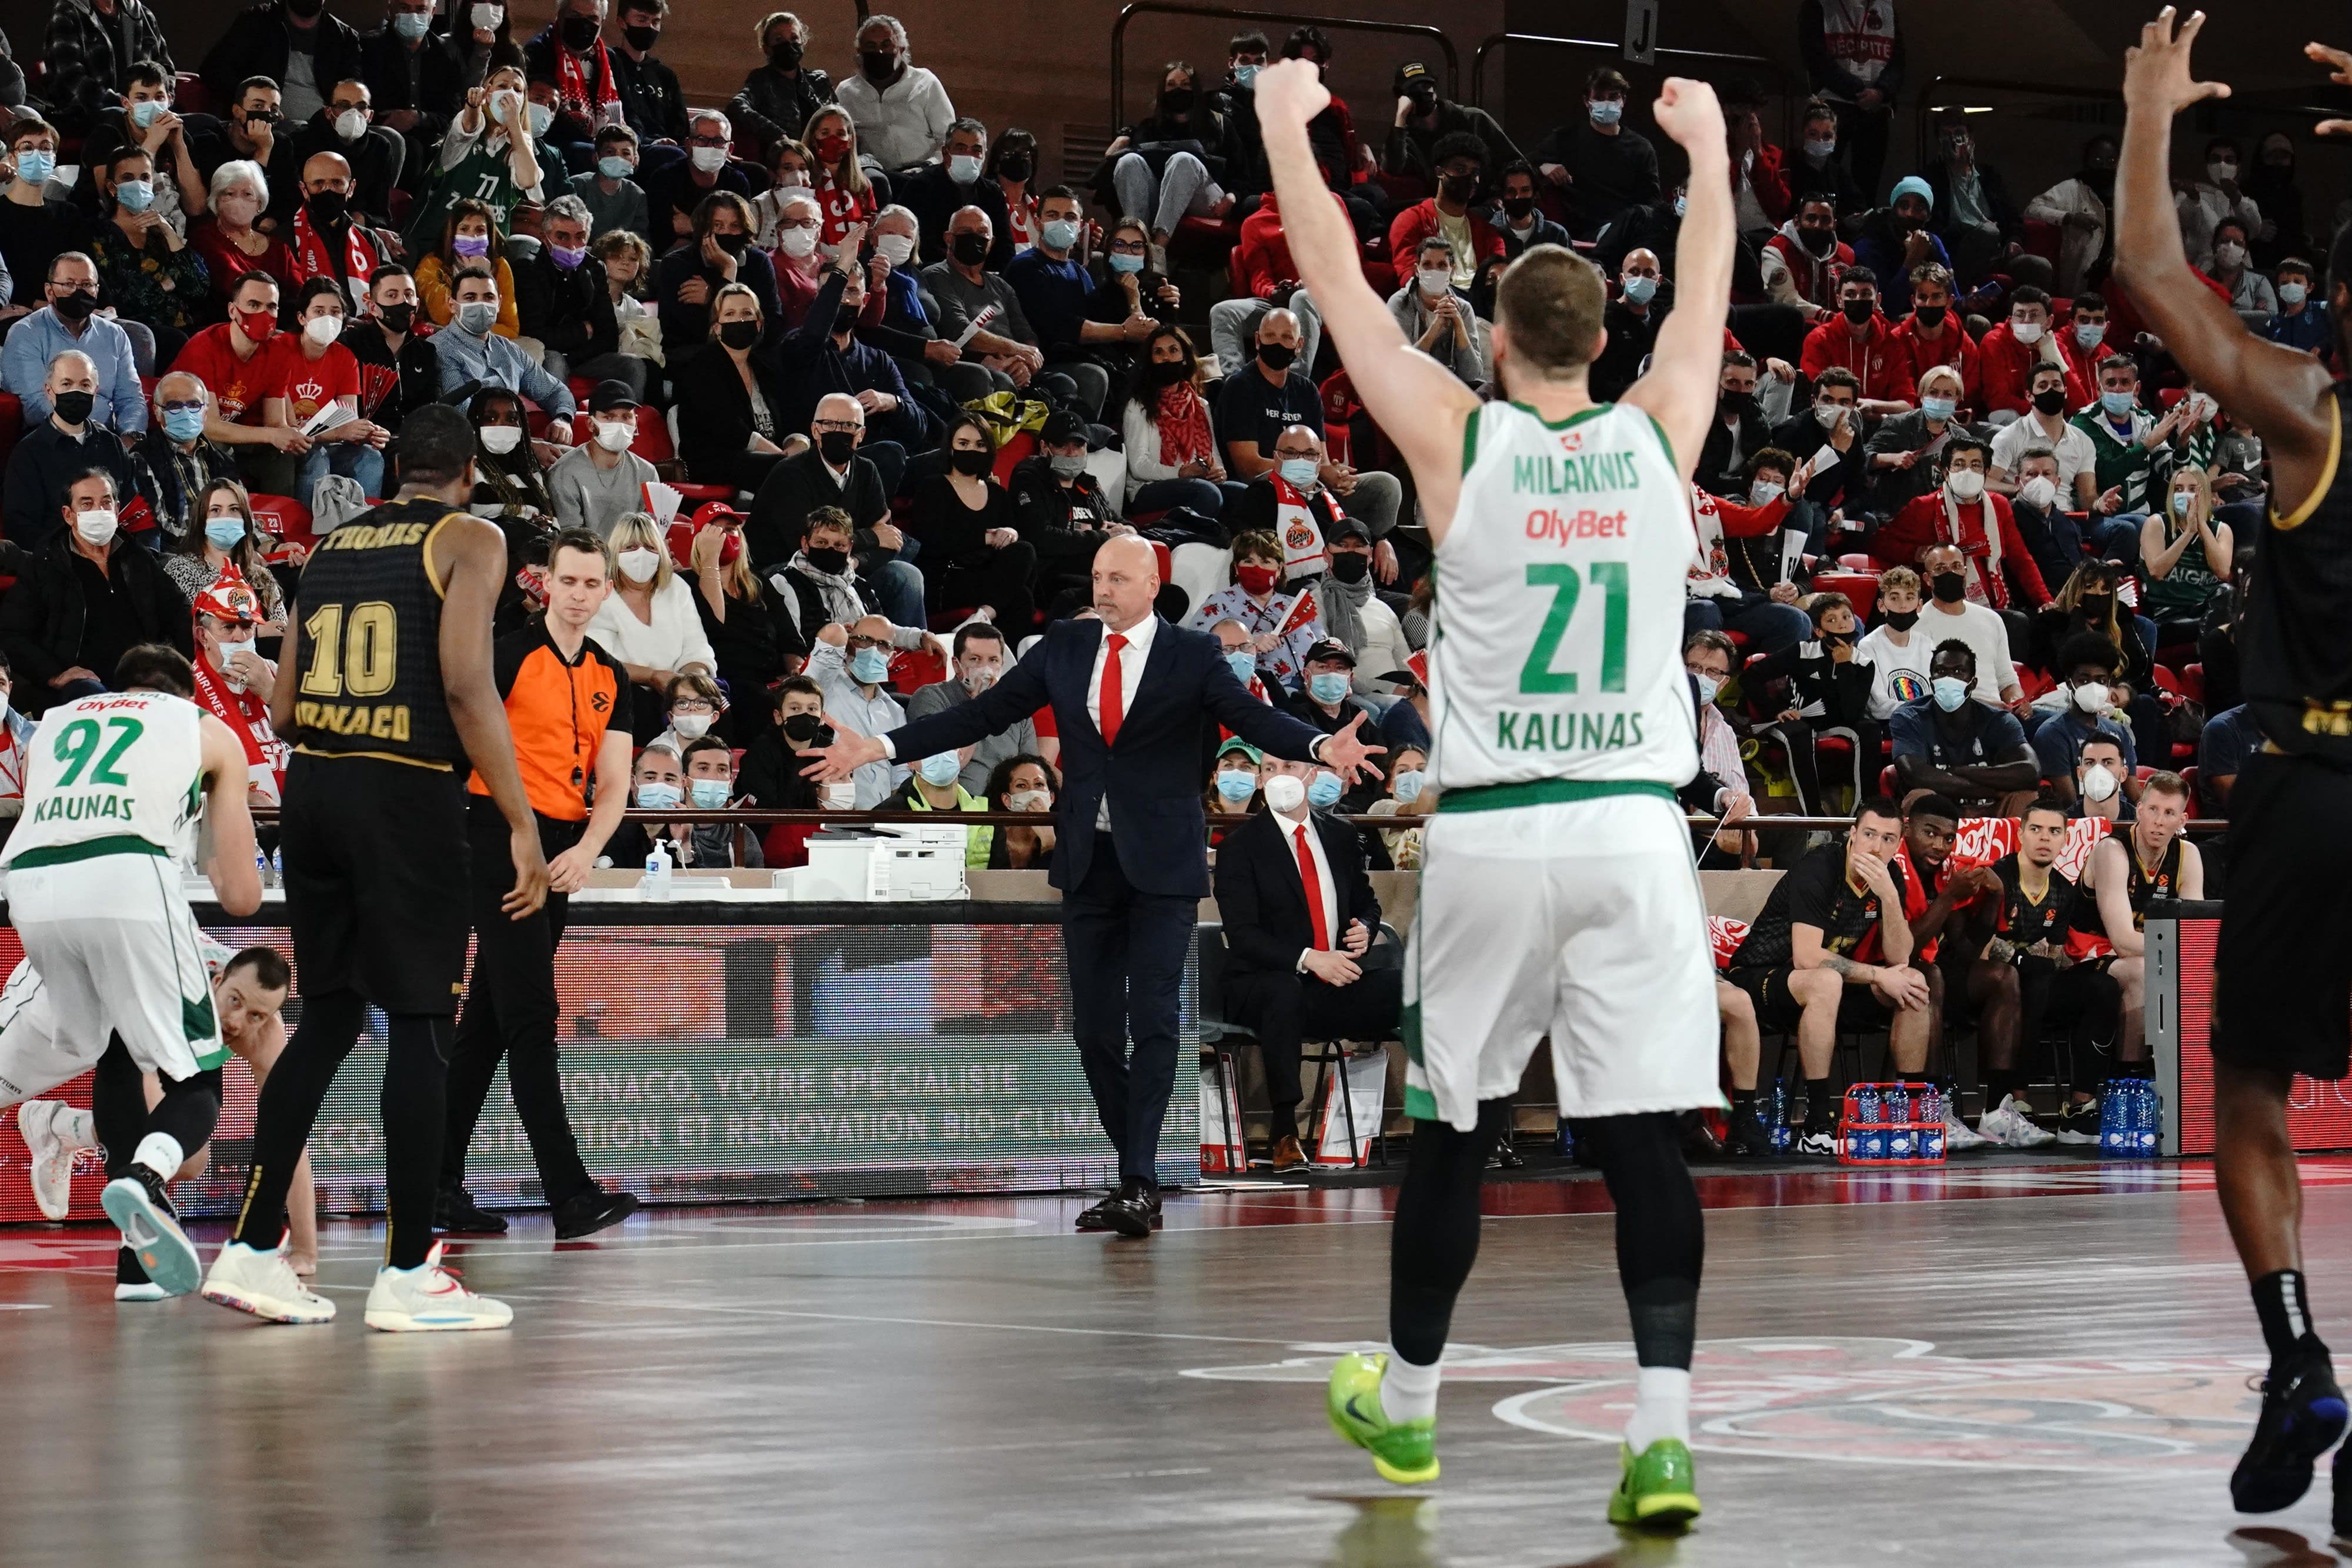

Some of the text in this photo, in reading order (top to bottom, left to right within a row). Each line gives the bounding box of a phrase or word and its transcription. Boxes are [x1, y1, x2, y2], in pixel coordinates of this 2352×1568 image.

[1632, 9, 1651, 54] J
[475, 173, 499, 200] 77
[1513, 450, 1641, 496] MILAKNIS
[268, 518, 278, 528] 23
[322, 523, 430, 551] THOMAS
[1525, 508, 1628, 548] OlyBet
[1519, 561, 1629, 694] 21
[300, 601, 397, 697] 10
[76, 698, 150, 712] OlyBet
[194, 671, 228, 718] AIRLINES
[295, 700, 410, 742] ONACO
[1496, 711, 1643, 753] KAUNAS
[53, 717, 144, 788] 92
[33, 794, 135, 825] KAUNAS
[713, 1065, 817, 1101] VOTRE
[830, 1059, 1020, 1098] SPÉCIALISTE
[679, 1115, 711, 1148] ET
[727, 1107, 927, 1148] RÉNOVATION
